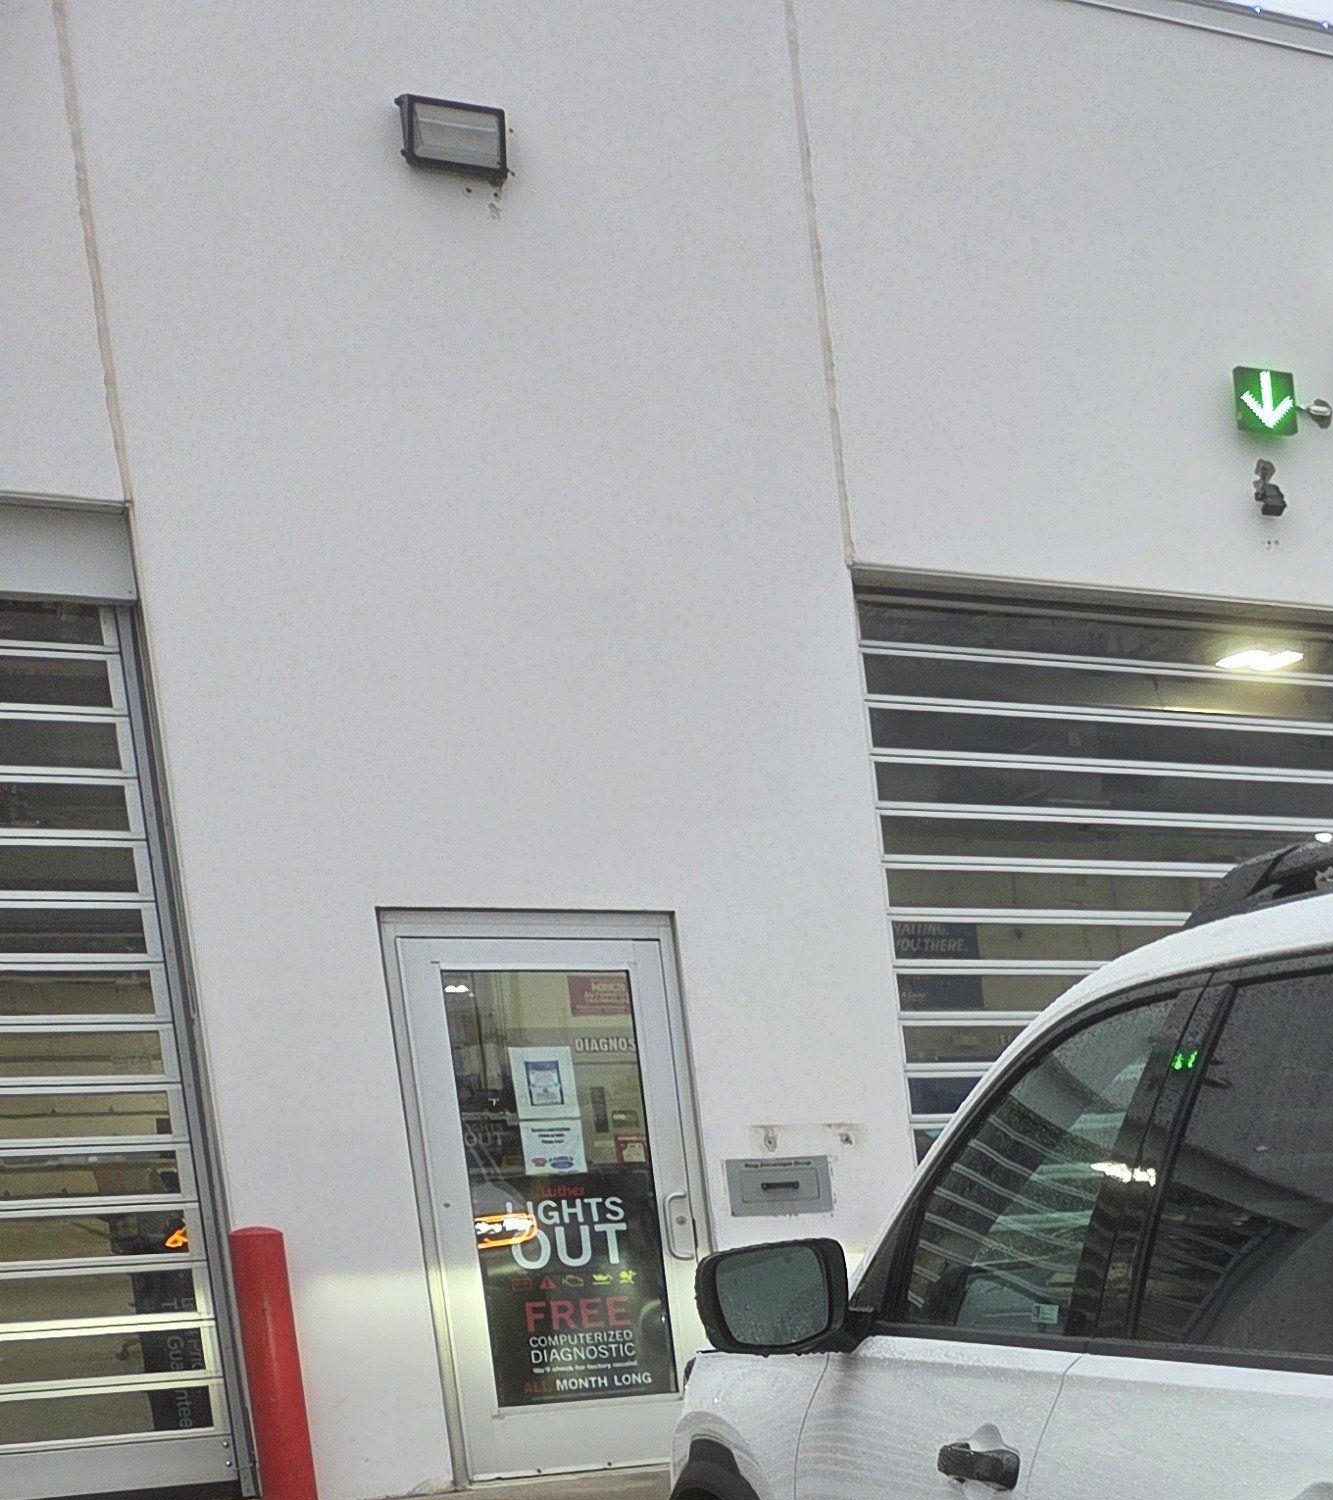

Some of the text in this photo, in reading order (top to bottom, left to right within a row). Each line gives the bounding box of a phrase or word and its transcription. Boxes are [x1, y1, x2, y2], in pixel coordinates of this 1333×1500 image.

[511, 1222, 627, 1270] OUT
[525, 1296, 632, 1332] FREE
[529, 1330, 633, 1348] COMPUTERIZED
[531, 1343, 636, 1364] DIAGNOSTIC
[166, 1335, 194, 1429] Guantee
[556, 1375, 608, 1391] MONTH
[613, 1372, 652, 1386] LONG
